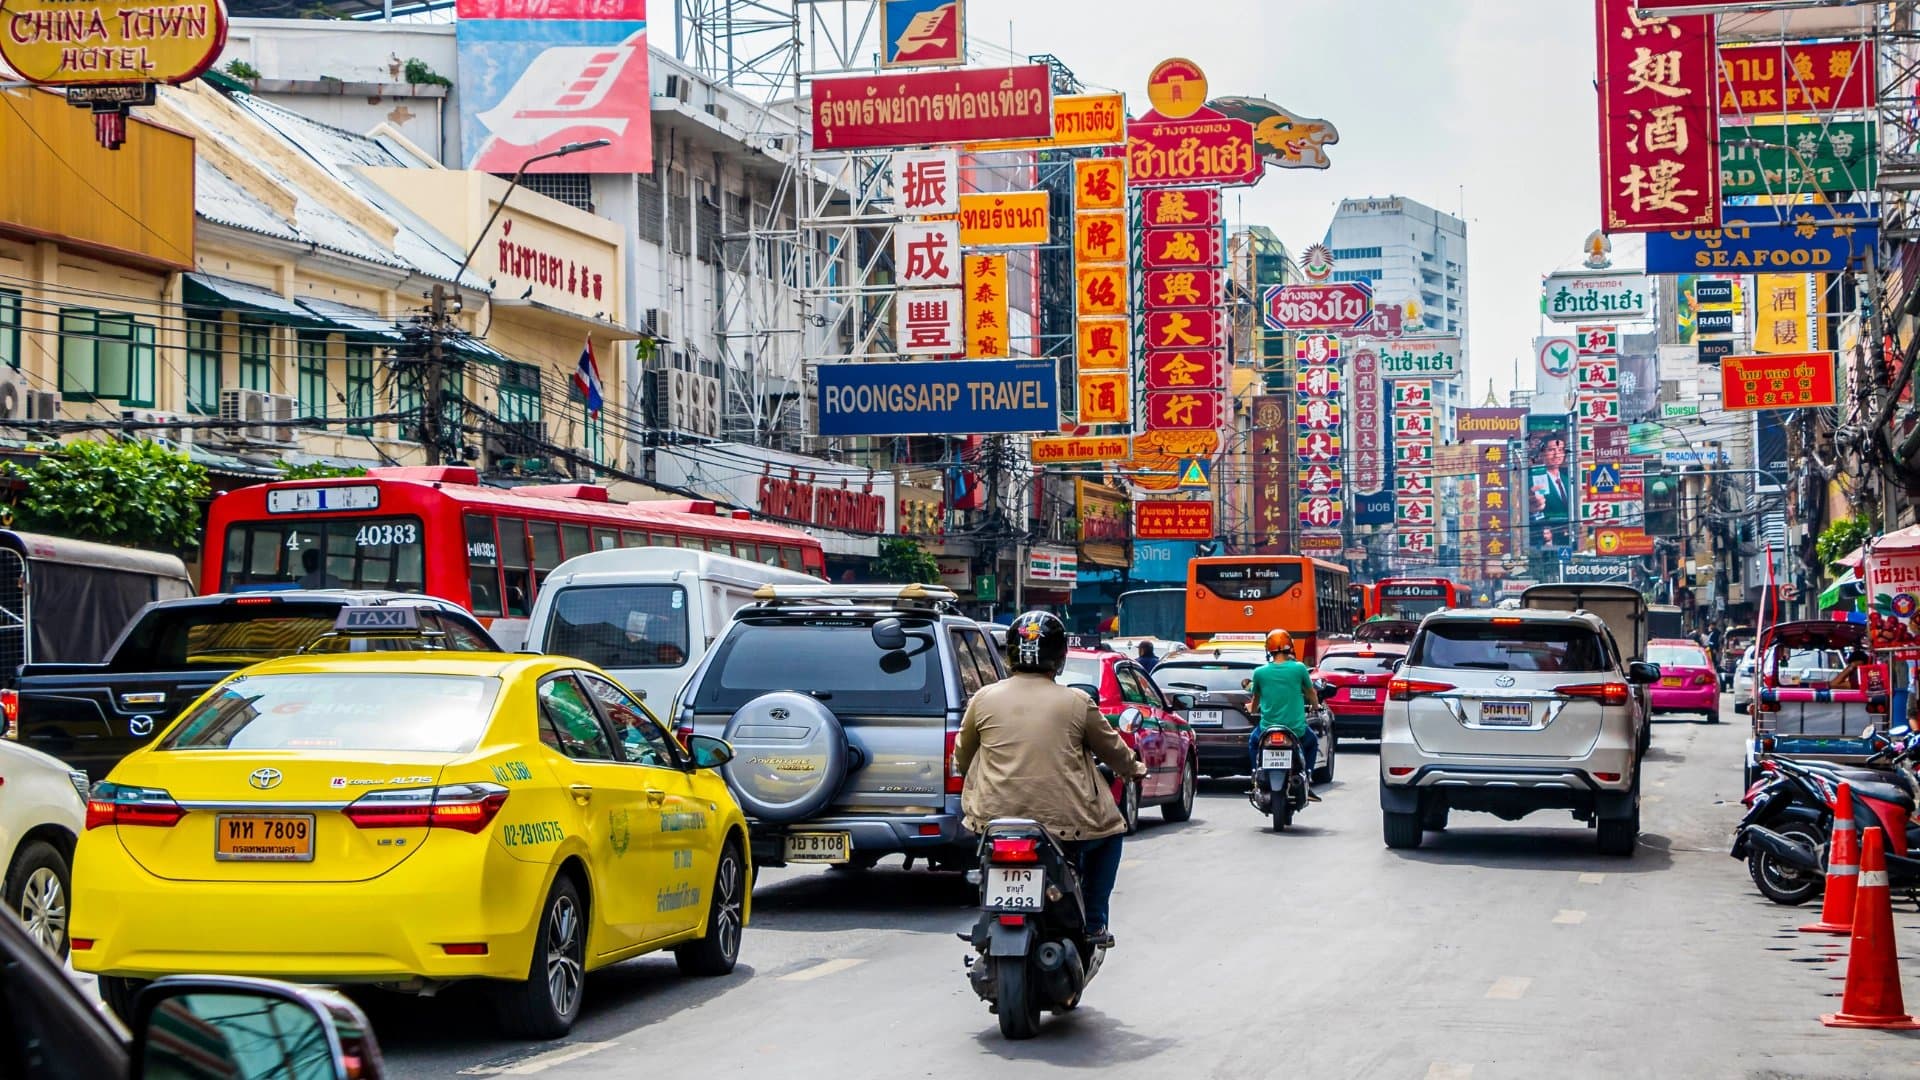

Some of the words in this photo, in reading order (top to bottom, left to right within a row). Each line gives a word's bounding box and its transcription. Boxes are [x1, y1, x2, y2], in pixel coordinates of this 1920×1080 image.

[10, 9, 109, 44] CHINA
[118, 6, 209, 39] TOWN
[61, 47, 156, 71] HOTEL
[1785, 86, 1831, 105] FIN
[1765, 166, 1834, 185] NEST
[902, 160, 951, 347] 振成豐
[1695, 249, 1832, 268] SEAFOOD
[1697, 287, 1730, 296] CITIZEN
[1155, 191, 1205, 427] 蘇成興大金行
[1771, 273, 1798, 345] 酒樓
[1699, 316, 1732, 325] RADO
[1703, 345, 1728, 354] MIDO
[826, 383, 960, 413] ROONGSARP
[967, 380, 1048, 409] TRAVEL
[1306, 336, 1332, 524] 馬利興大金行
[1666, 452, 1704, 461] BROADWAY
[1404, 386, 1425, 550] 和成興大金行
[317, 489, 329, 509] 1
[1367, 503, 1391, 512] UOB
[355, 524, 416, 546] 40383
[1246, 568, 1251, 578] 1
[1404, 586, 1420, 596] 40
[352, 612, 403, 626] TAXI
[390, 776, 432, 785] ALTIS
[229, 821, 254, 839] ทห
[264, 821, 307, 839] 7809
[811, 836, 843, 850] 8108
[1002, 869, 1032, 883] 1กจ
[994, 896, 1034, 907] 2493
